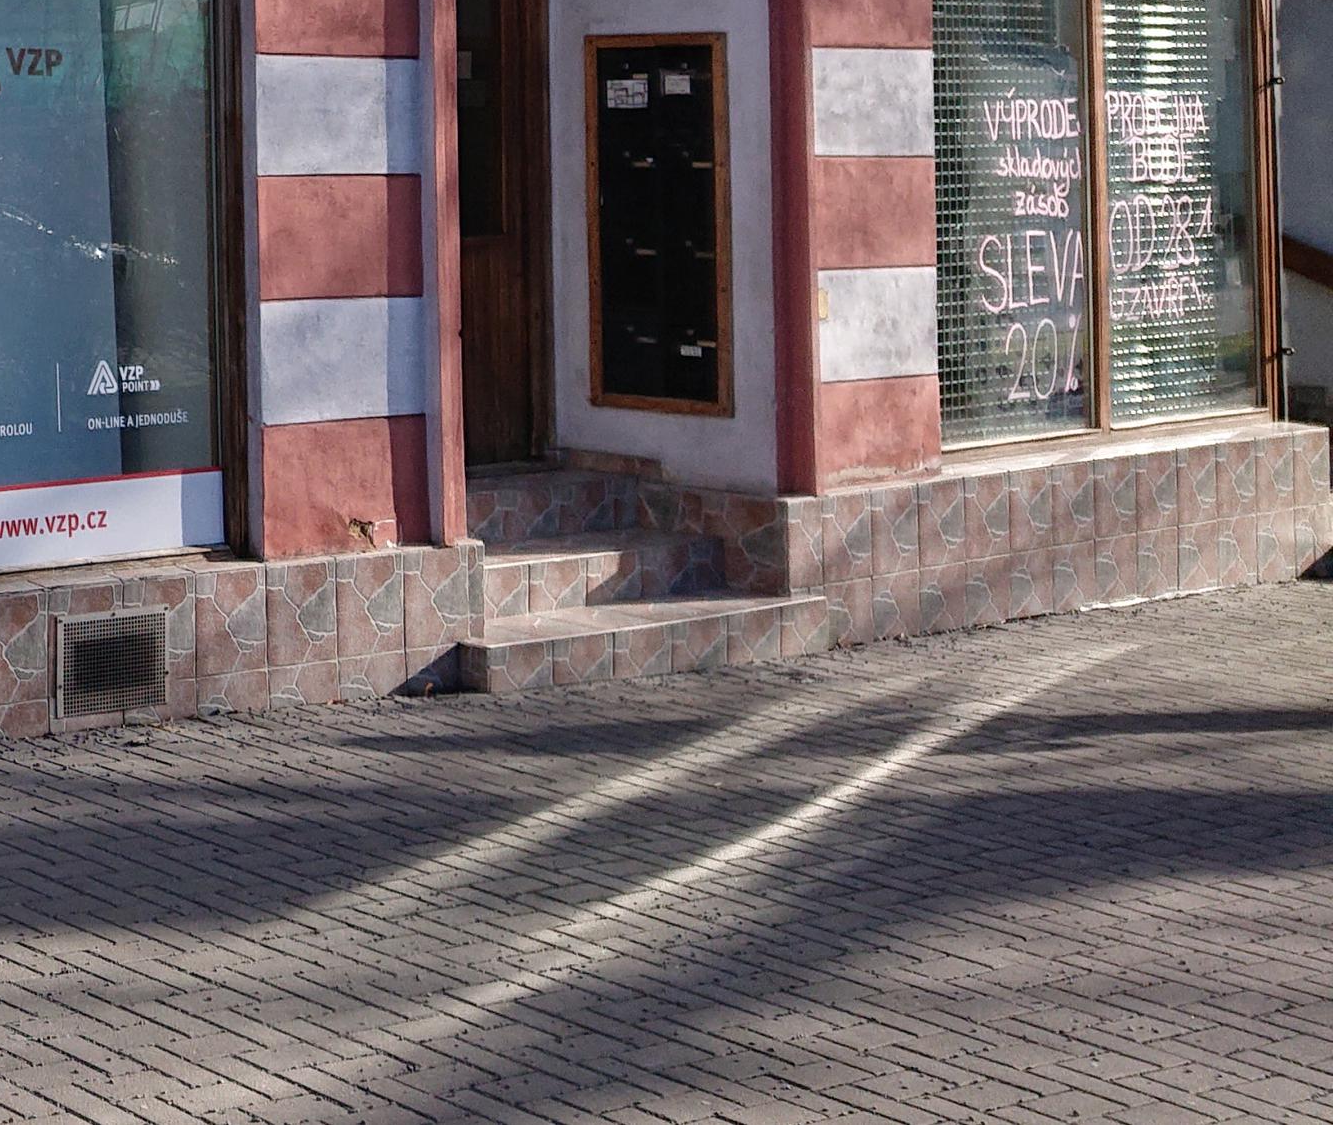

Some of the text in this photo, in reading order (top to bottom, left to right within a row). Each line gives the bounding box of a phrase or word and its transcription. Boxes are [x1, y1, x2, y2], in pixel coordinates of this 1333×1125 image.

[5, 47, 63, 77] VZP
[983, 87, 1081, 141] VÝPRODE
[1104, 90, 1207, 138] PRODEJNA
[1129, 133, 1198, 184] BUDE
[1109, 194, 1156, 275] OD
[979, 228, 1085, 315] SLEVA
[119, 365, 144, 381] VZP
[122, 380, 150, 393] POINT
[87, 408, 189, 430] ON-LINE A JEDNODUŠE
